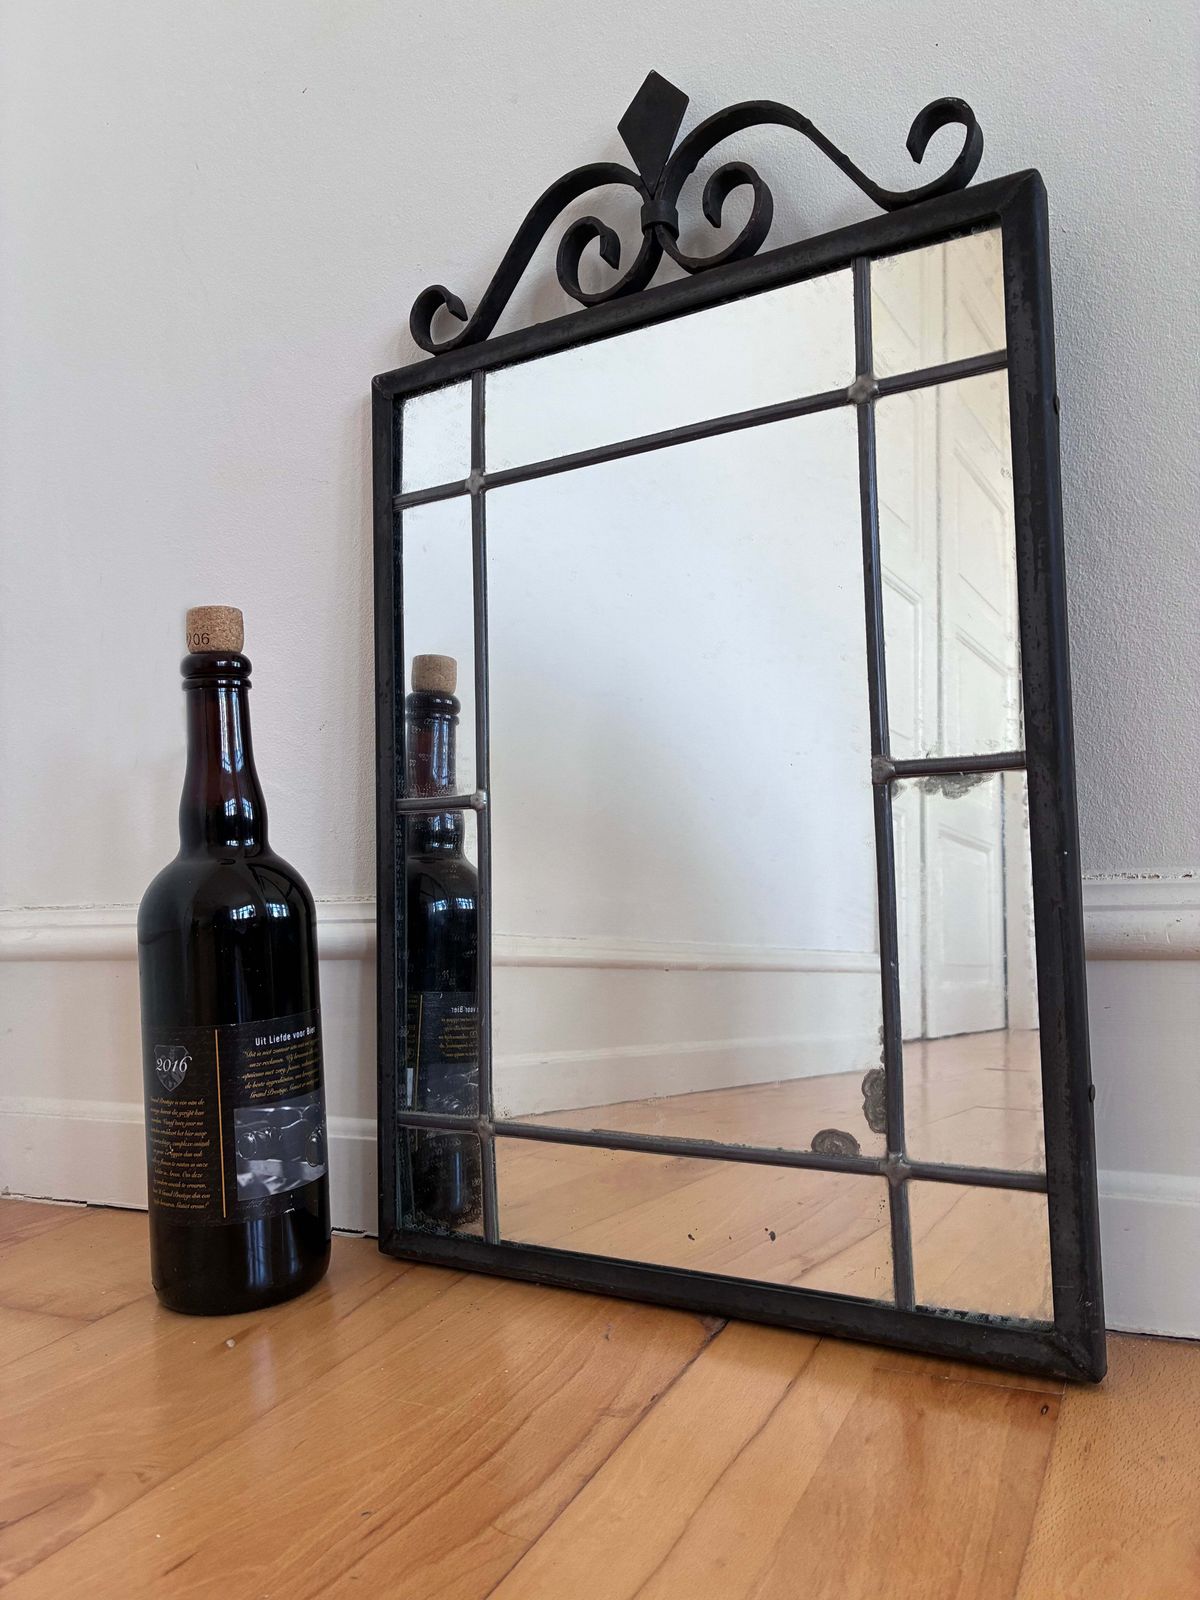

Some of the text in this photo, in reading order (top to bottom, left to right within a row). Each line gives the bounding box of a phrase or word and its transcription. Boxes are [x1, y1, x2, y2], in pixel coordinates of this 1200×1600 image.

[255, 1037, 267, 1046] Uit
[269, 1033, 291, 1044] Liefde
[292, 1030, 305, 1039] voor
[156, 1055, 192, 1073] 2016
